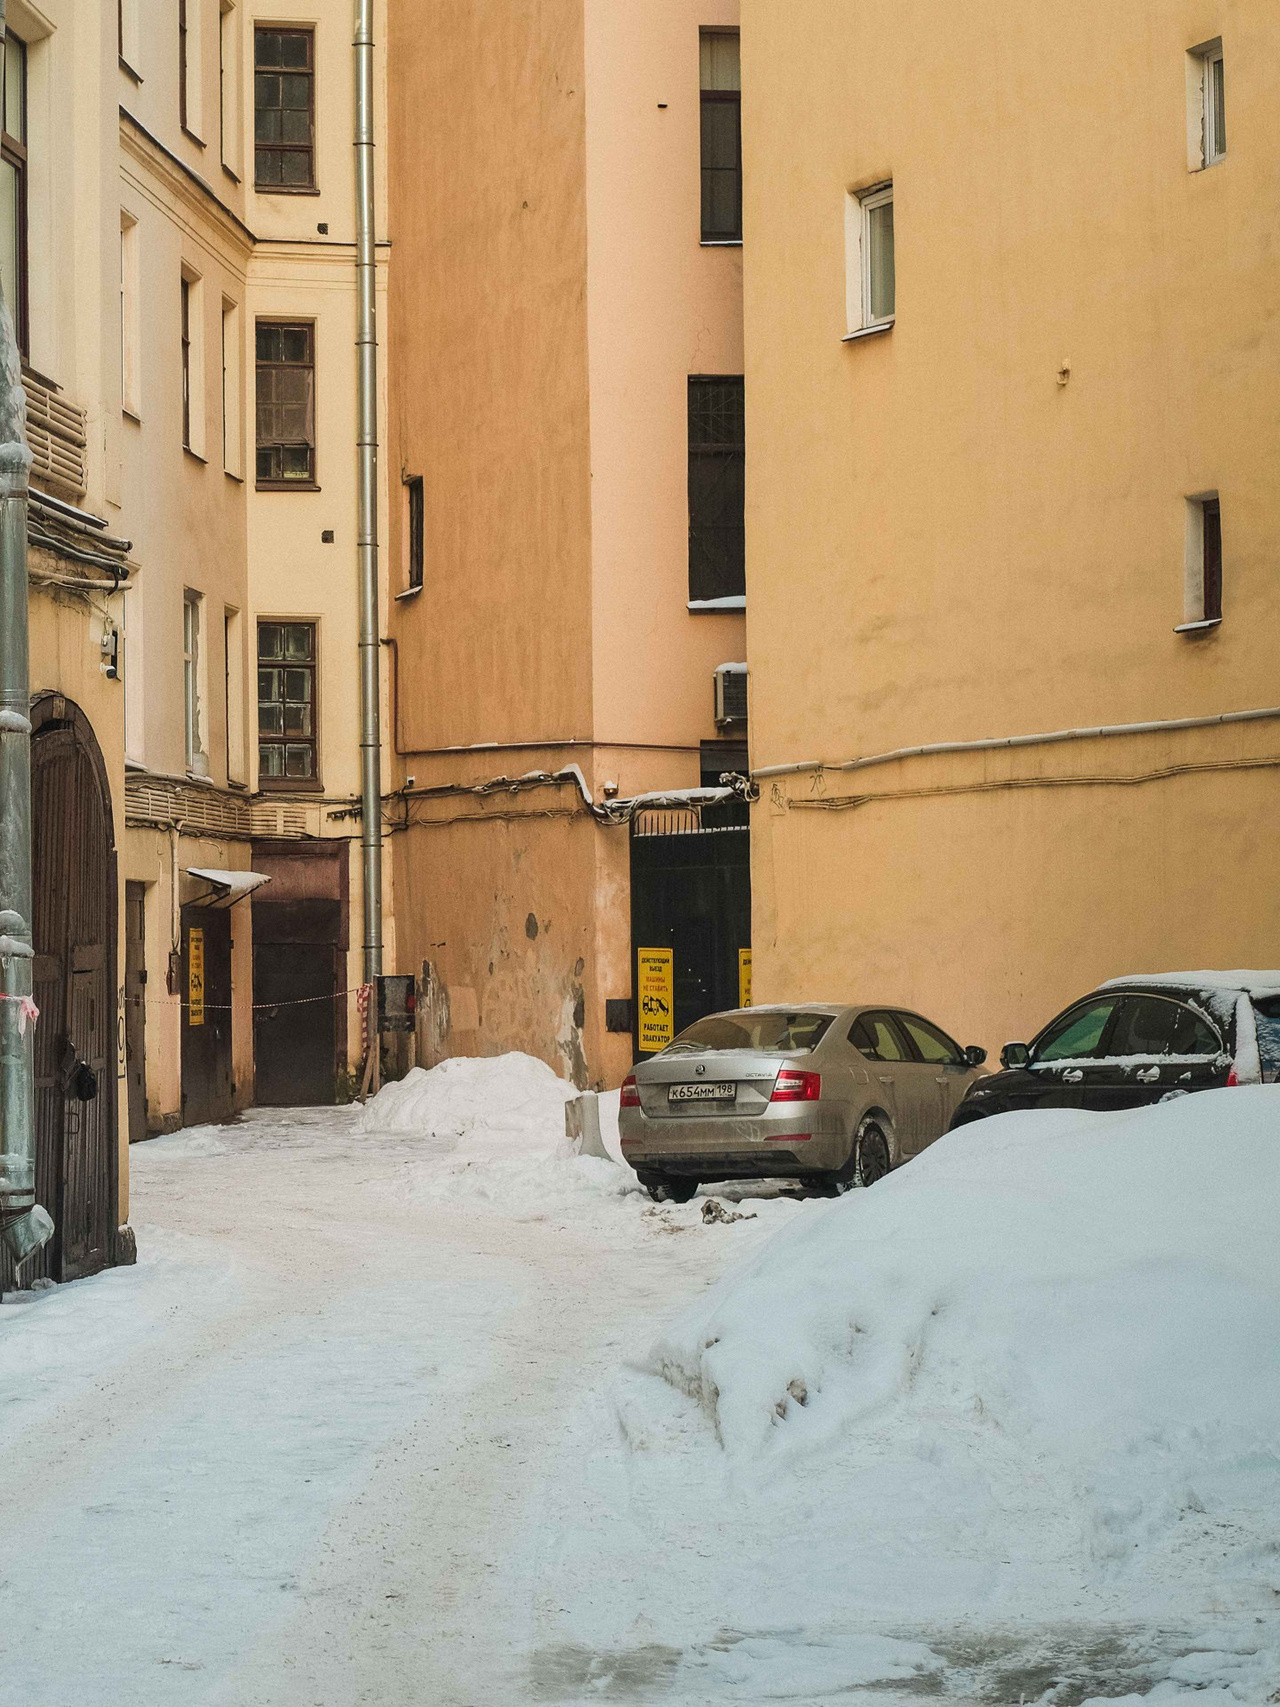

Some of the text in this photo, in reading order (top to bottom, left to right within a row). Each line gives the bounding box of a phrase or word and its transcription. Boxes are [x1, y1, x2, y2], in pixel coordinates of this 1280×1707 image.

[643, 1023, 669, 1032] РАБОТАЕТ
[642, 1034, 670, 1043] ЭВАКУАТОР
[716, 1084, 733, 1094] 198
